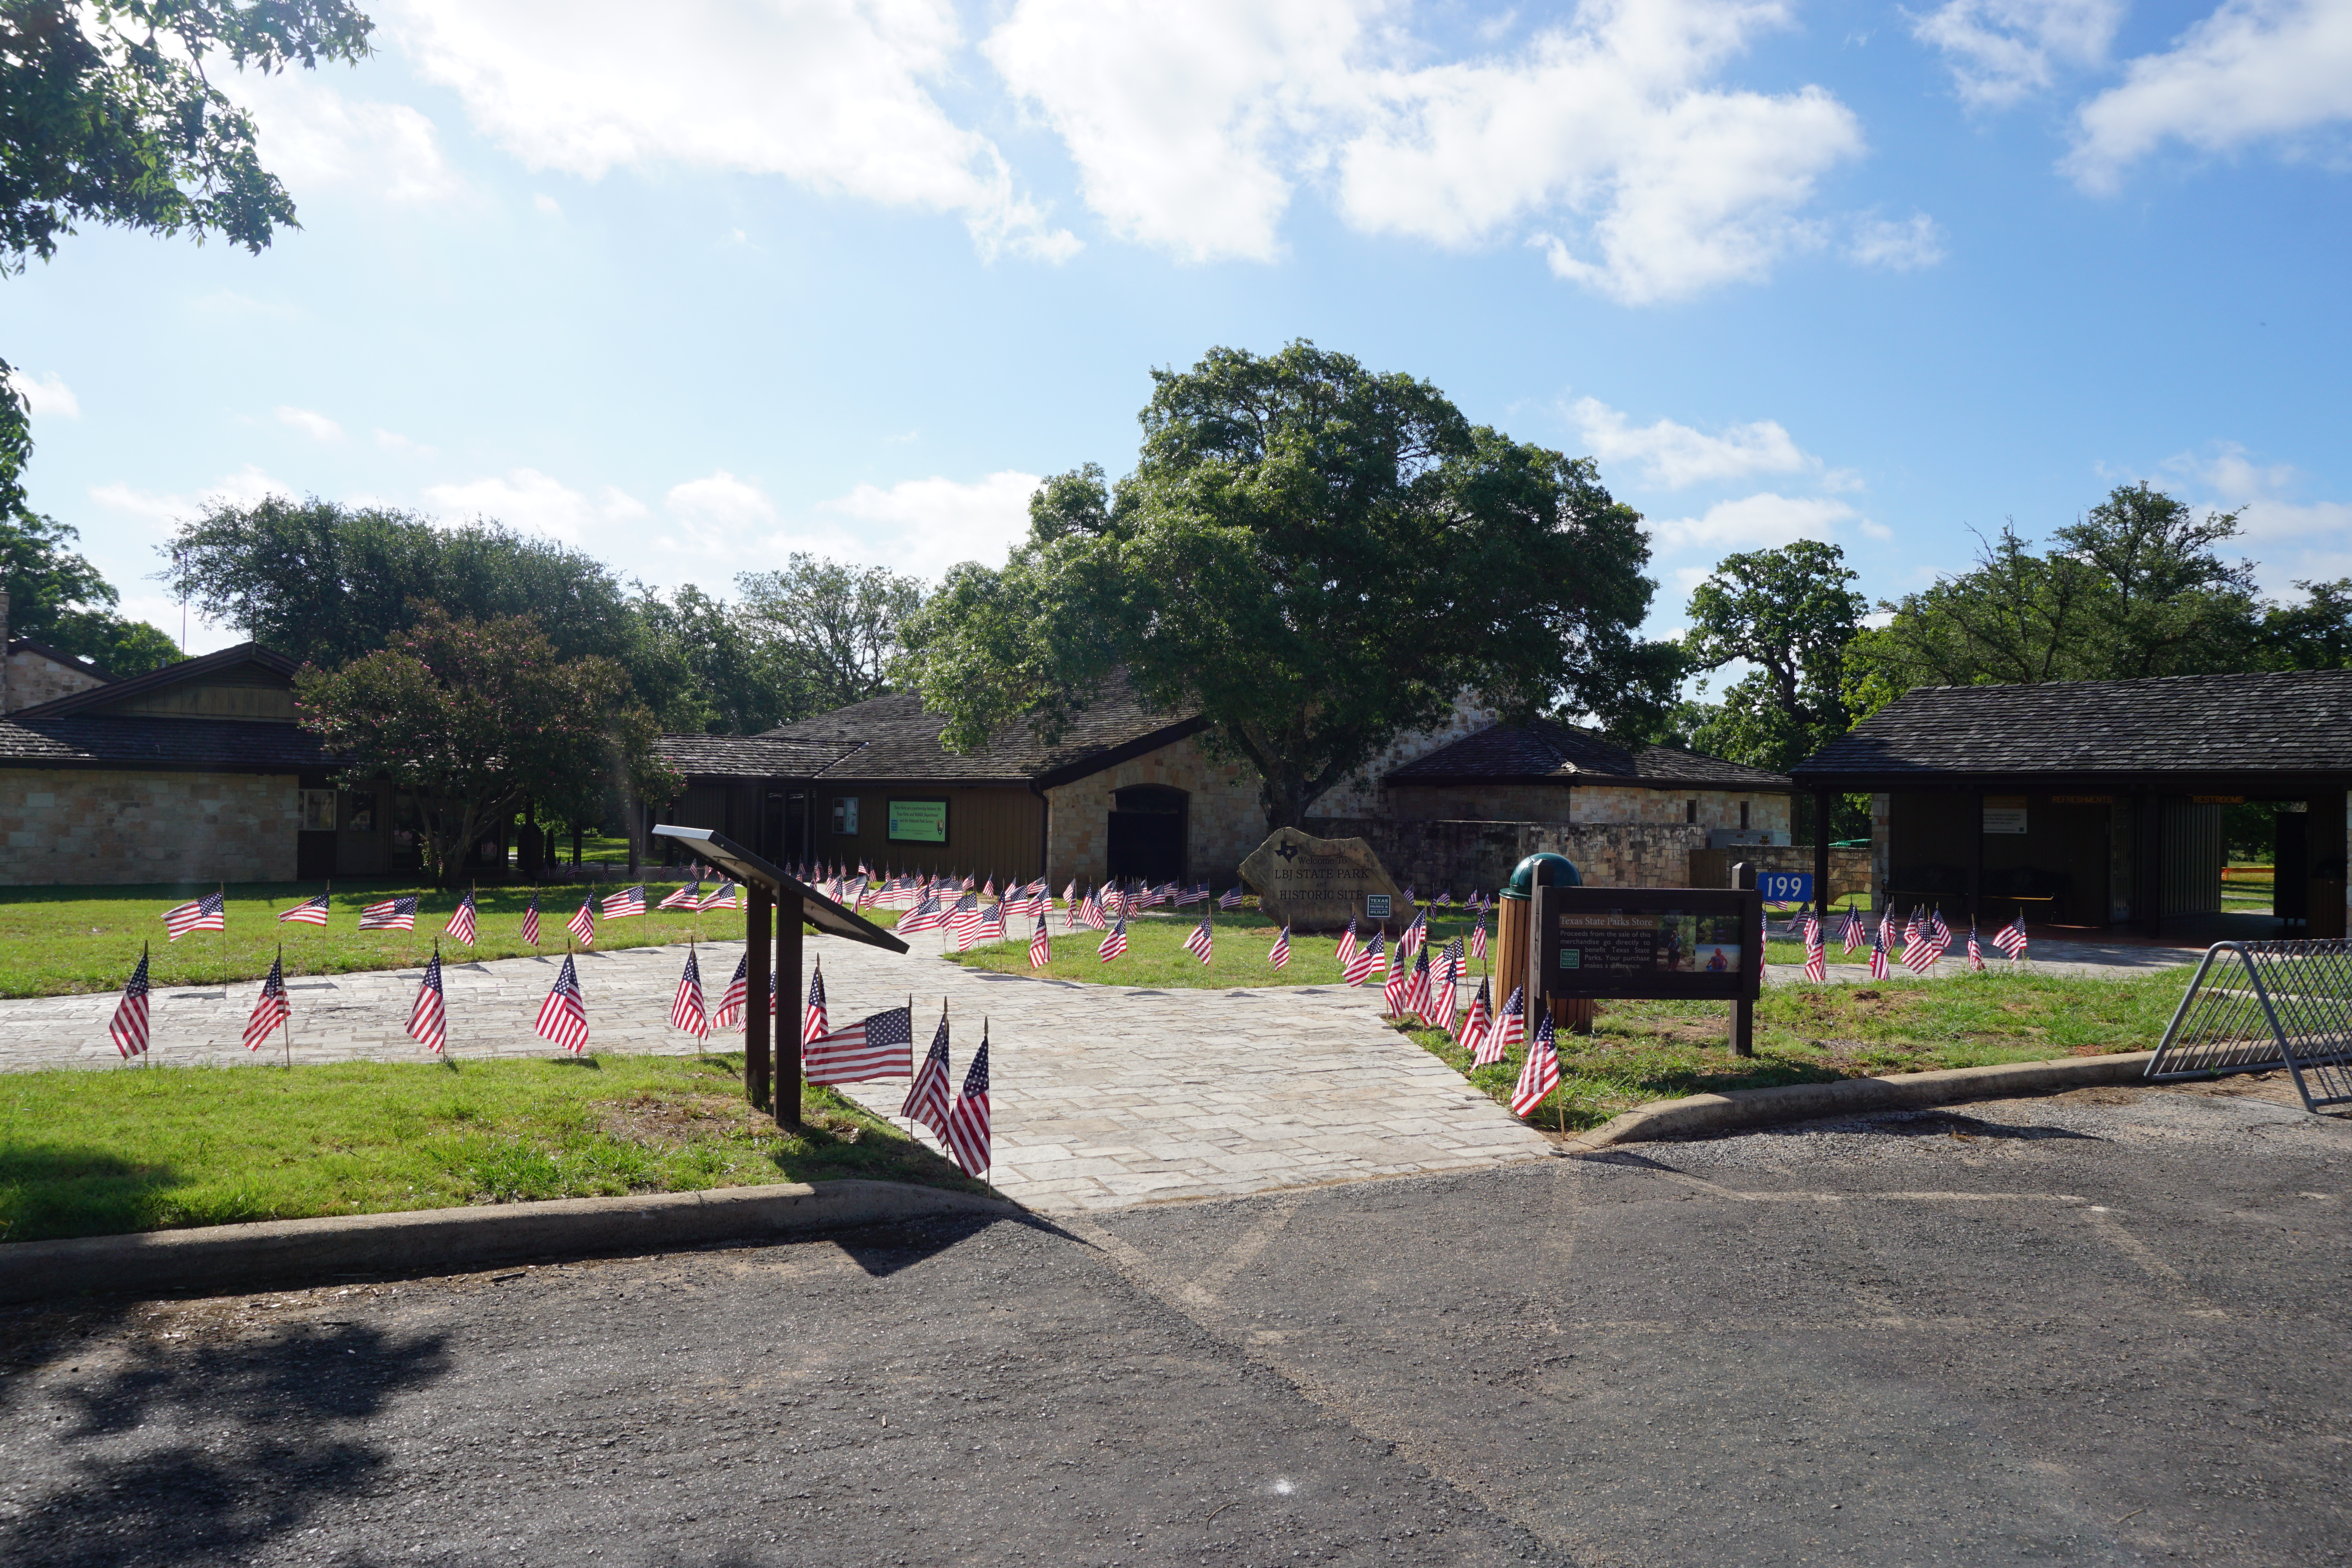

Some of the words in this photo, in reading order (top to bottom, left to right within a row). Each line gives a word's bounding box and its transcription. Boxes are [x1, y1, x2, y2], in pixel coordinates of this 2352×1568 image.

[1275, 870, 1292, 880] LBJ
[1296, 869, 1333, 878] STATE
[1338, 869, 1368, 878] PARK
[1768, 877, 1802, 897] 199
[1279, 890, 1334, 900] HISTORIC
[1338, 890, 1363, 900] SITE
[1560, 916, 1583, 925] Texas
[1585, 917, 1604, 925] State
[1607, 917, 1629, 926] Parks
[1632, 918, 1653, 926] Store
